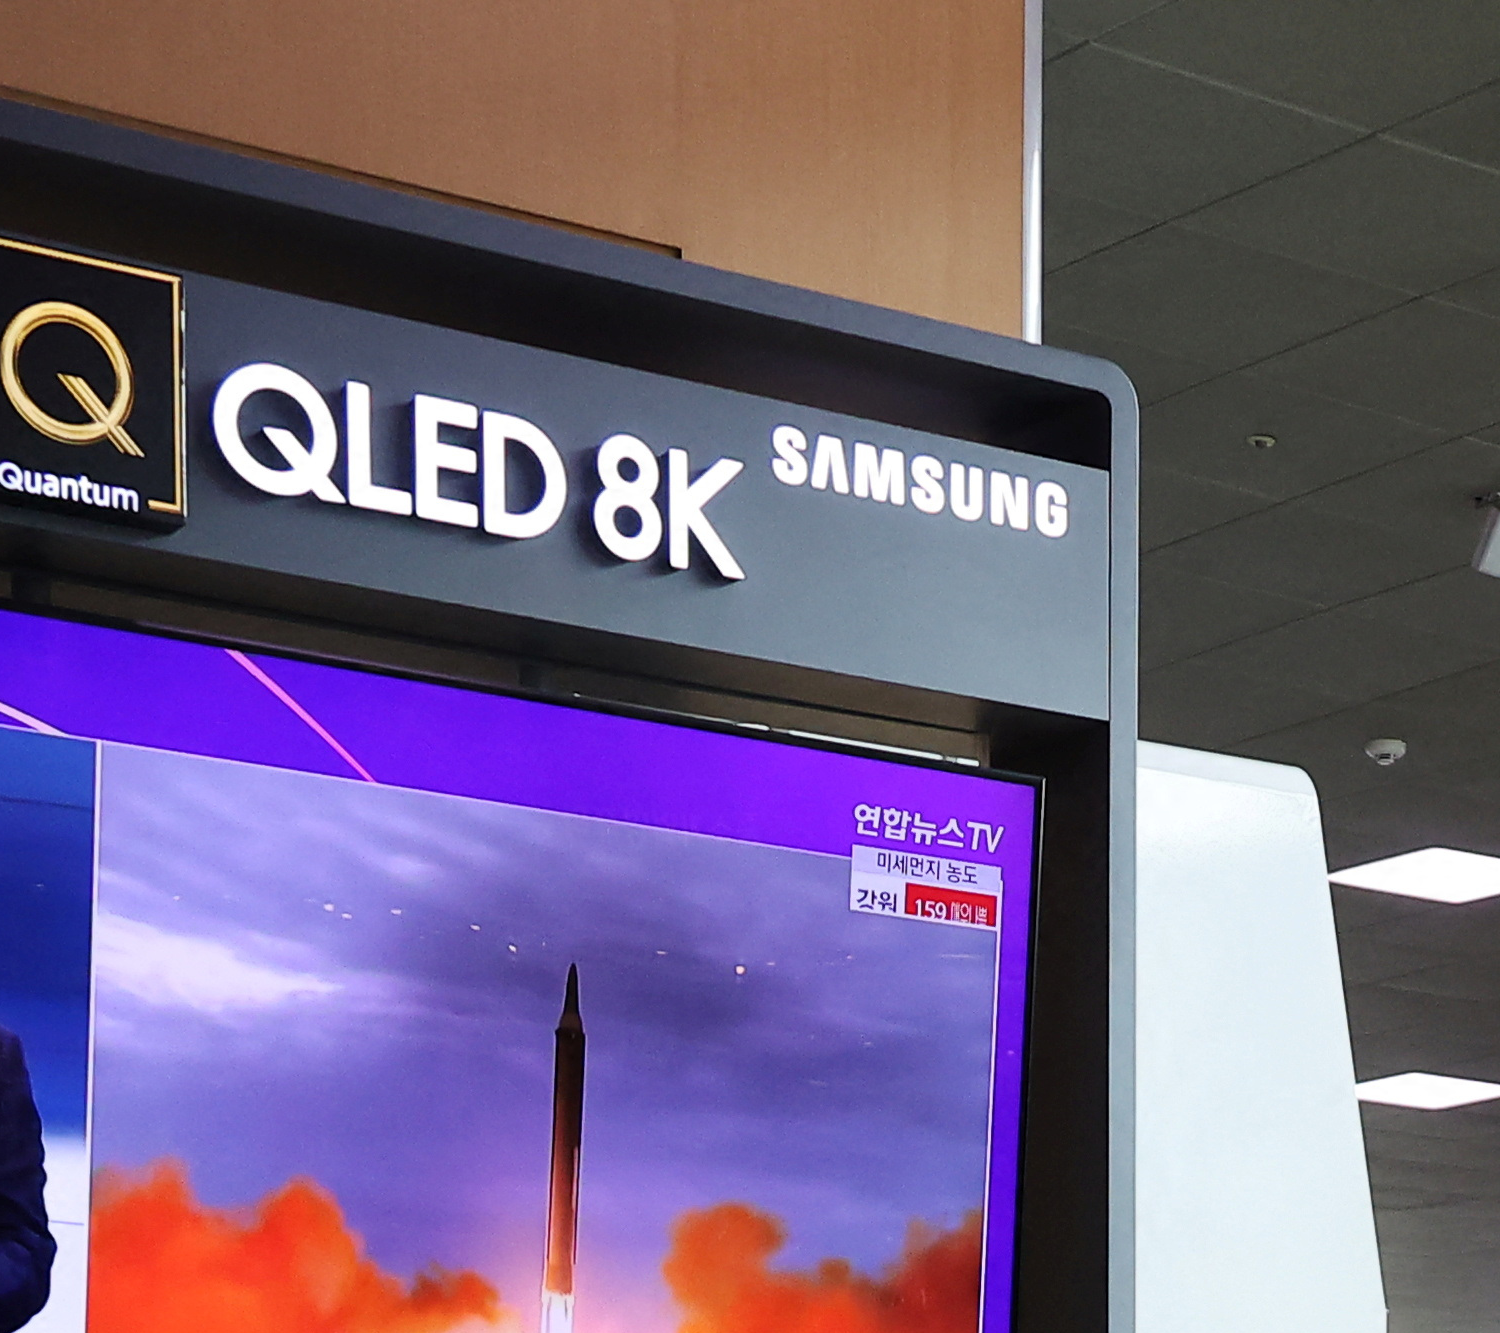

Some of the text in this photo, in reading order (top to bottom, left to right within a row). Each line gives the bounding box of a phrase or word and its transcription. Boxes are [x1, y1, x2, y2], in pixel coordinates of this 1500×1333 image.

[210, 361, 748, 582] QLED 8K
[769, 422, 1070, 541] SAMSUNG
[853, 802, 1005, 854] 연합뉴스TV
[876, 851, 979, 885] 미세먼지 농도
[914, 897, 948, 920] 159
